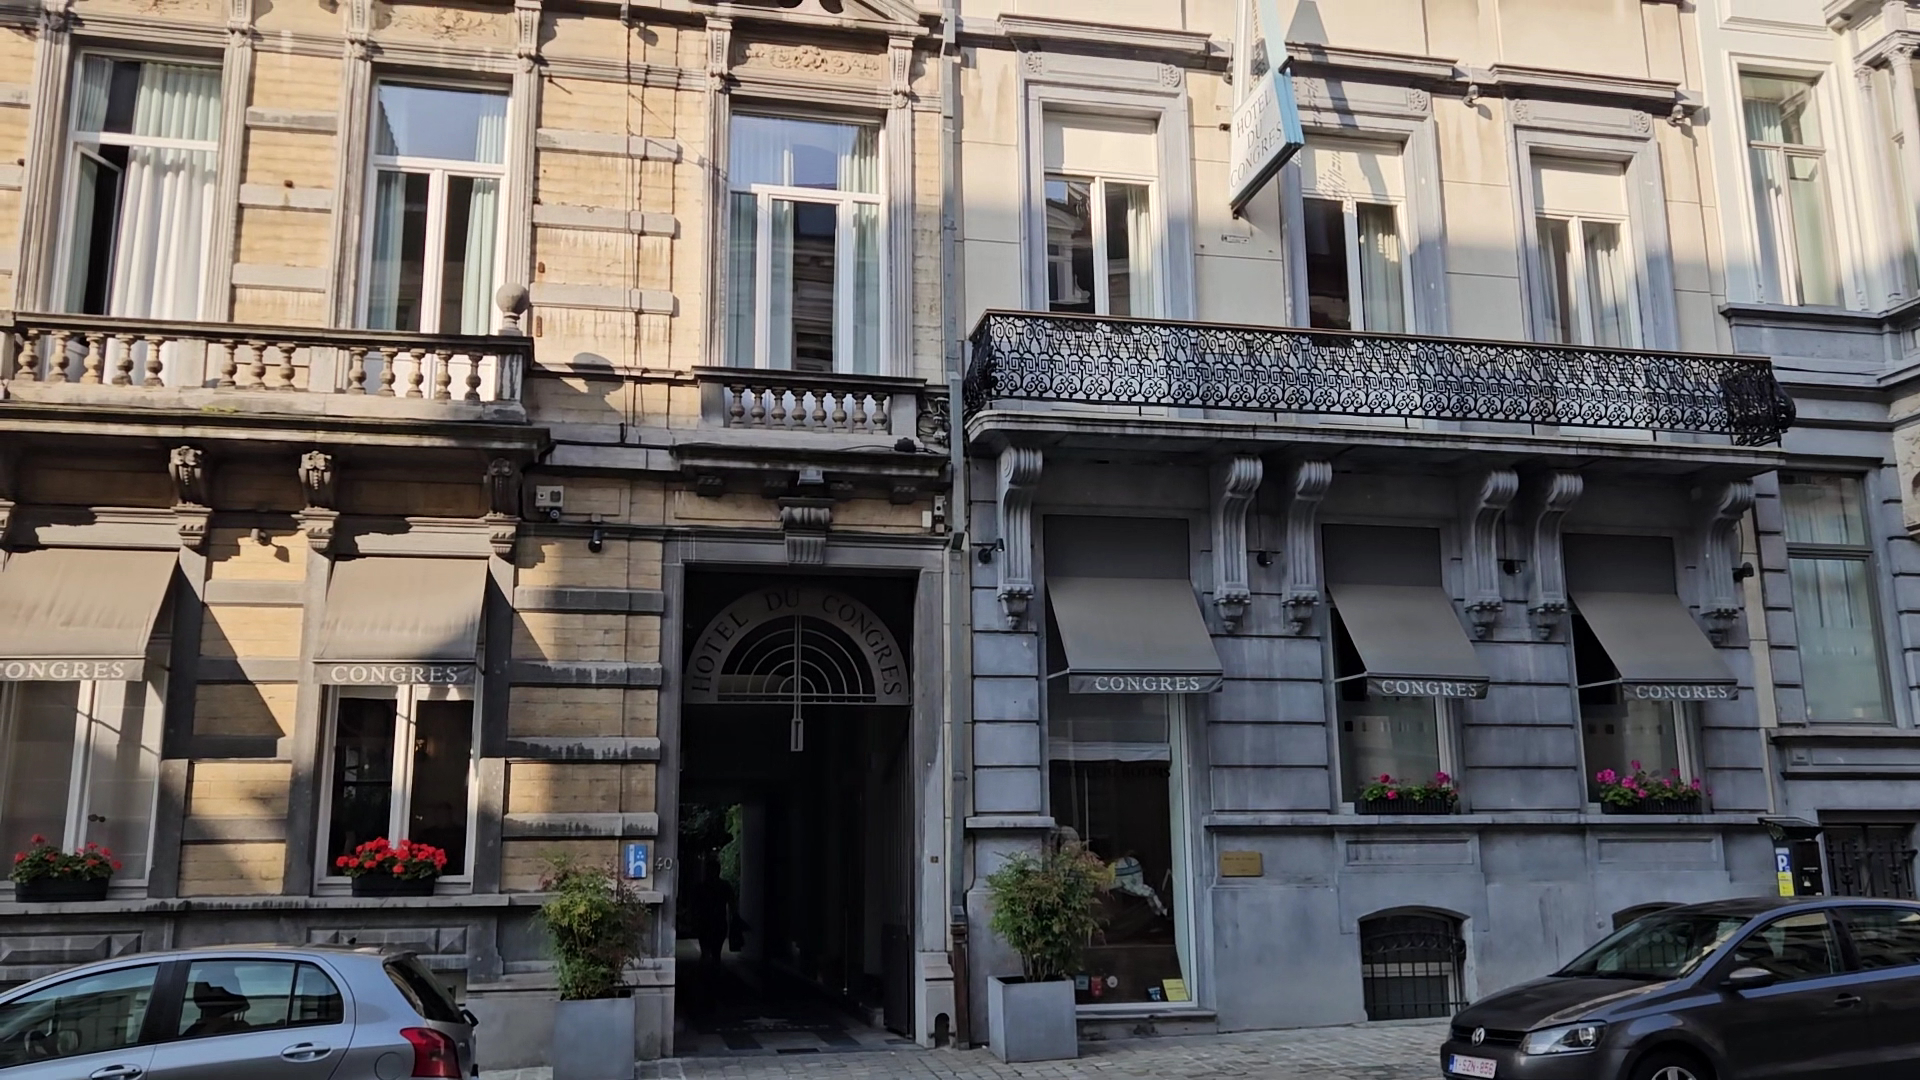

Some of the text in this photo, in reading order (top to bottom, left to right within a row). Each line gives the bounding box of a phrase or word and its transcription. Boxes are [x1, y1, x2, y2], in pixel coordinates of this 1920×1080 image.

[1237, 90, 1271, 138] HOTEL
[1247, 119, 1263, 149] DU
[1231, 121, 1281, 187] CONGRES
[691, 588, 902, 696] HOTEL DU CONGRES
[0, 661, 125, 679] ONGRES
[331, 666, 458, 683] CONGRES
[1095, 676, 1201, 691] CONGRES
[1381, 680, 1477, 697] CONGRES
[1636, 685, 1728, 699] CONGRES
[655, 857, 673, 871] 40
[1777, 855, 1788, 872] P
